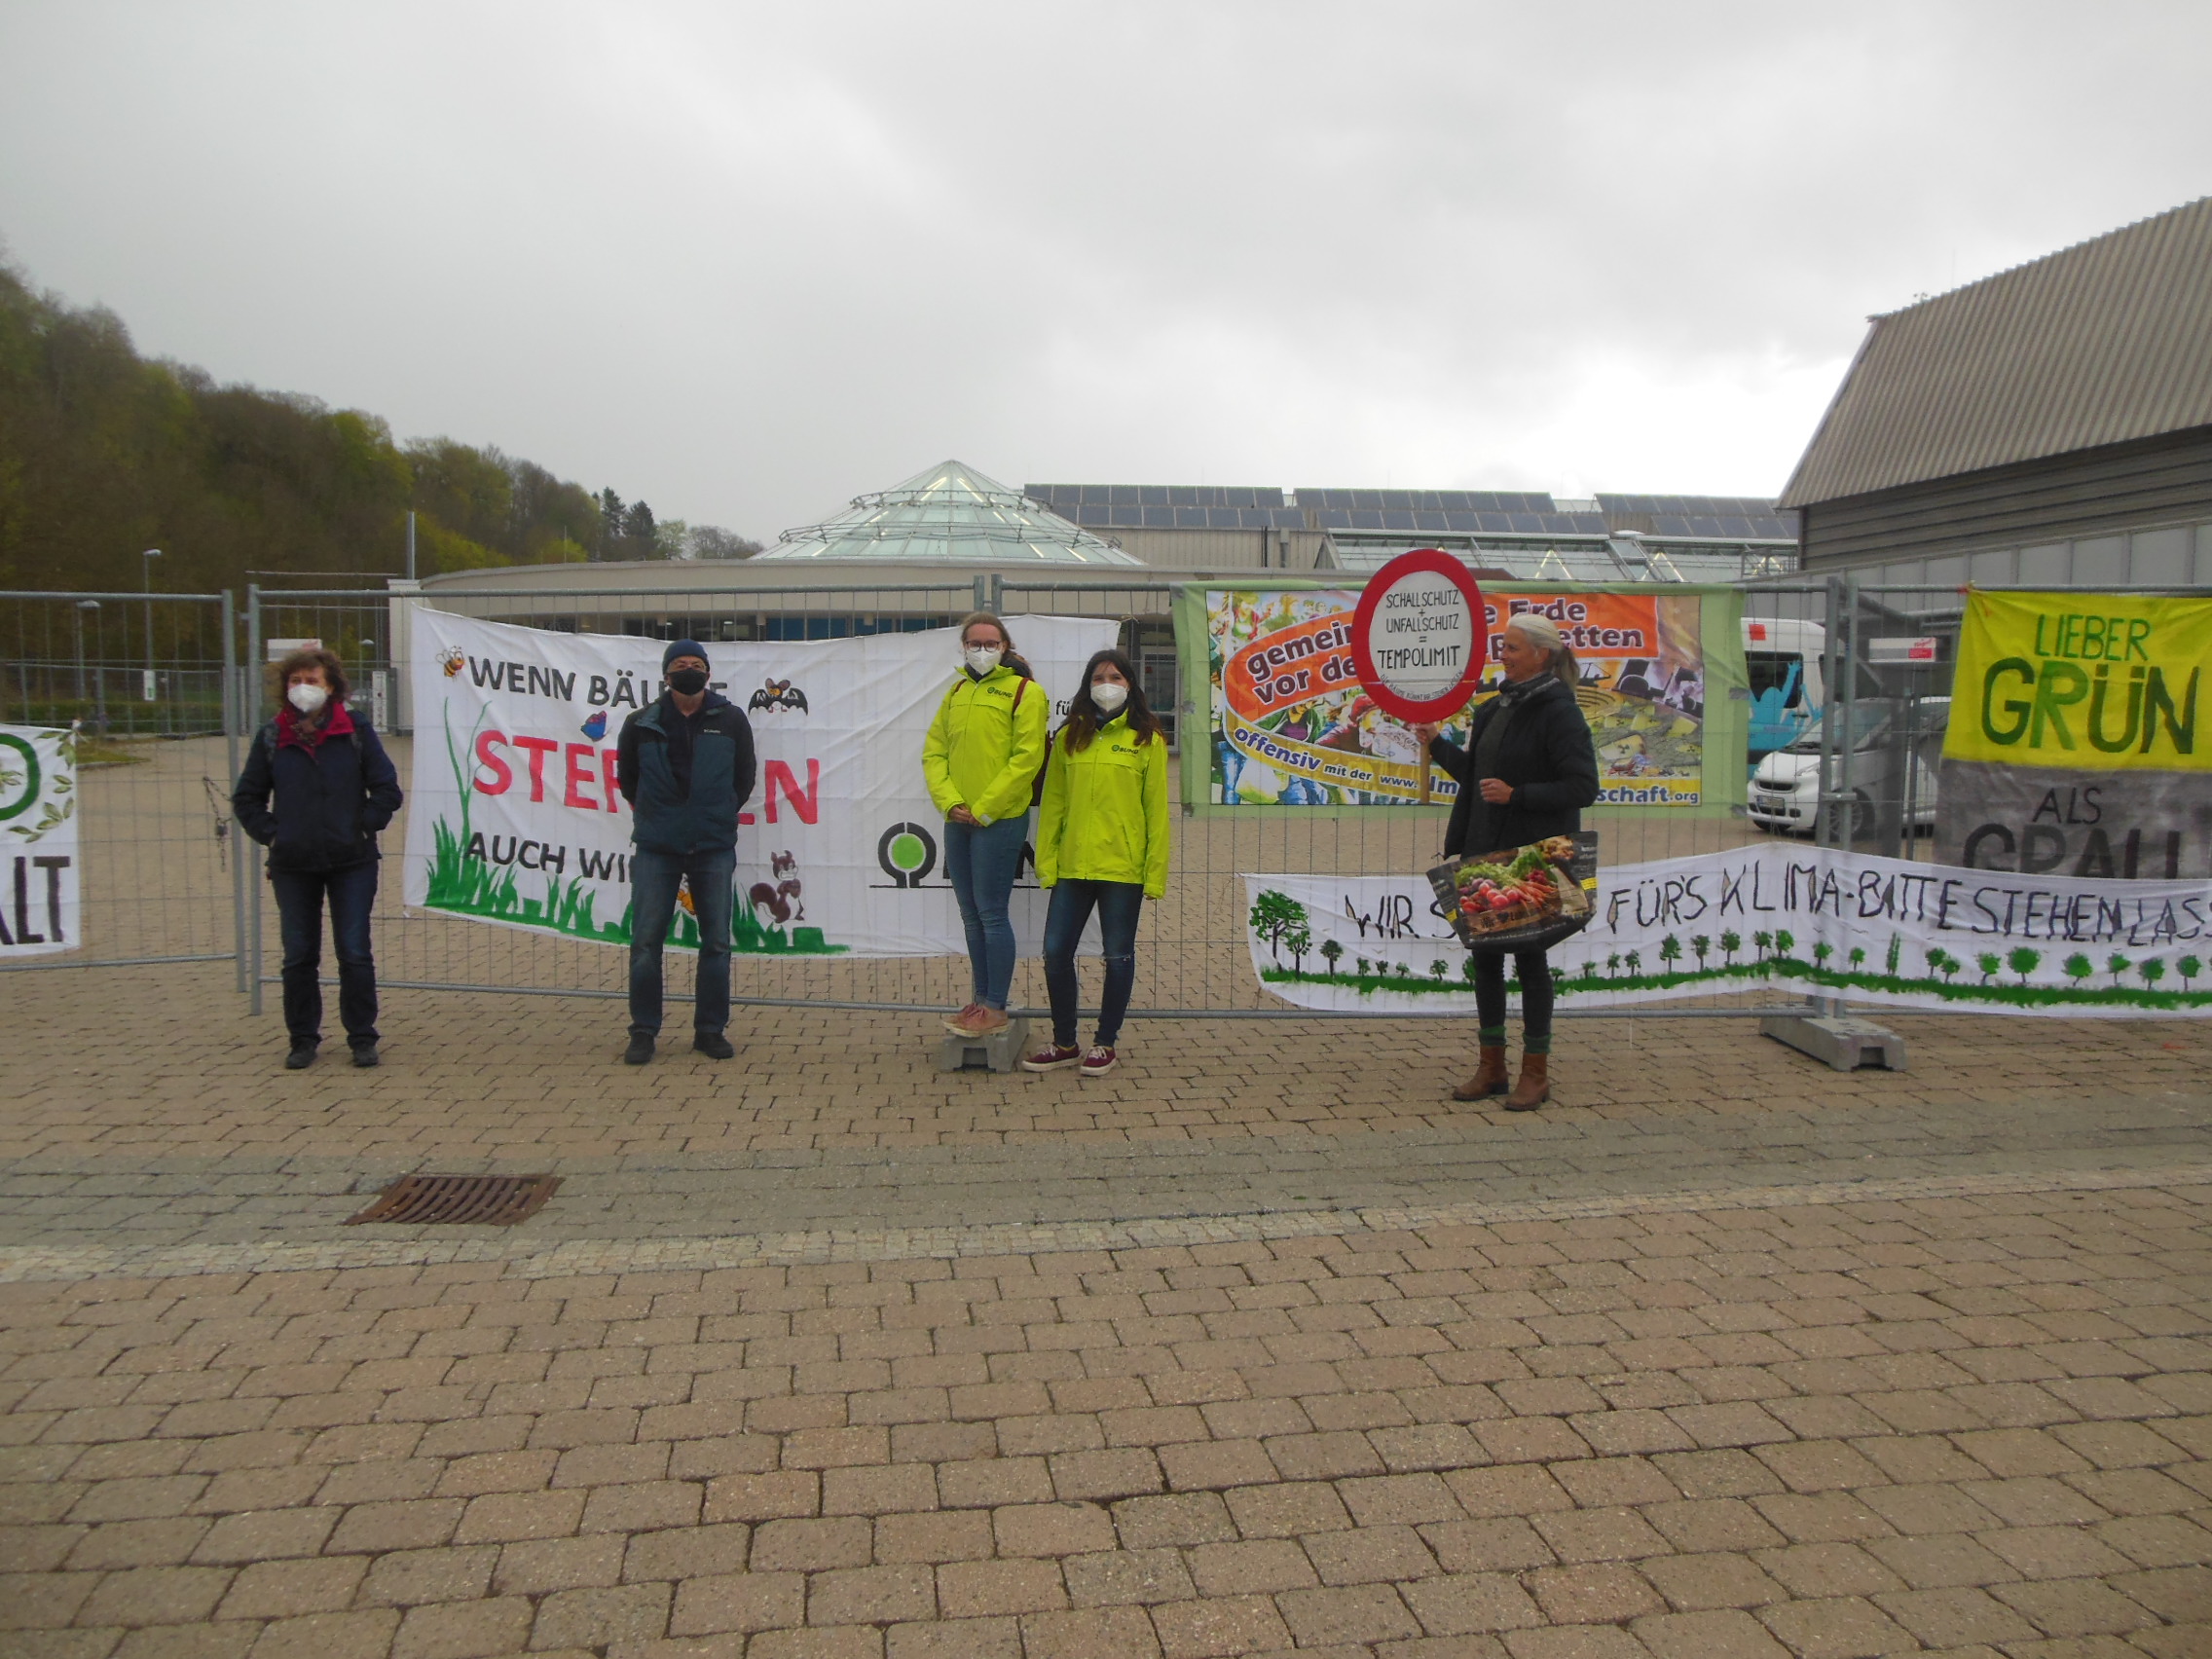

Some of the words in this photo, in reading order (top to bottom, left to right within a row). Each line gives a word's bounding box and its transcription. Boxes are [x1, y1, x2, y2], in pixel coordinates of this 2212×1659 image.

[1386, 589, 1459, 608] SCHALLSCHUTZ
[1386, 613, 1459, 633] UNFALLSCHUTZ
[2035, 614, 2152, 661] LIEBER
[1254, 670, 1309, 703] vor
[1321, 655, 1358, 682] de
[1378, 645, 1461, 670] TEMPOLIMIT
[468, 656, 575, 702] WENN
[587, 669, 728, 709] BÄUE
[1981, 656, 2200, 755] GRÜN
[1055, 700, 1070, 716] fü
[1235, 727, 1321, 770] offensiv
[1324, 763, 1346, 777] mit
[1350, 769, 1372, 781] der
[2032, 786, 2103, 825] ALS
[463, 832, 566, 874] AUCH
[0, 856, 71, 944] LT
[1346, 894, 1420, 940] WIR
[1972, 887, 2121, 942] STEHEN
